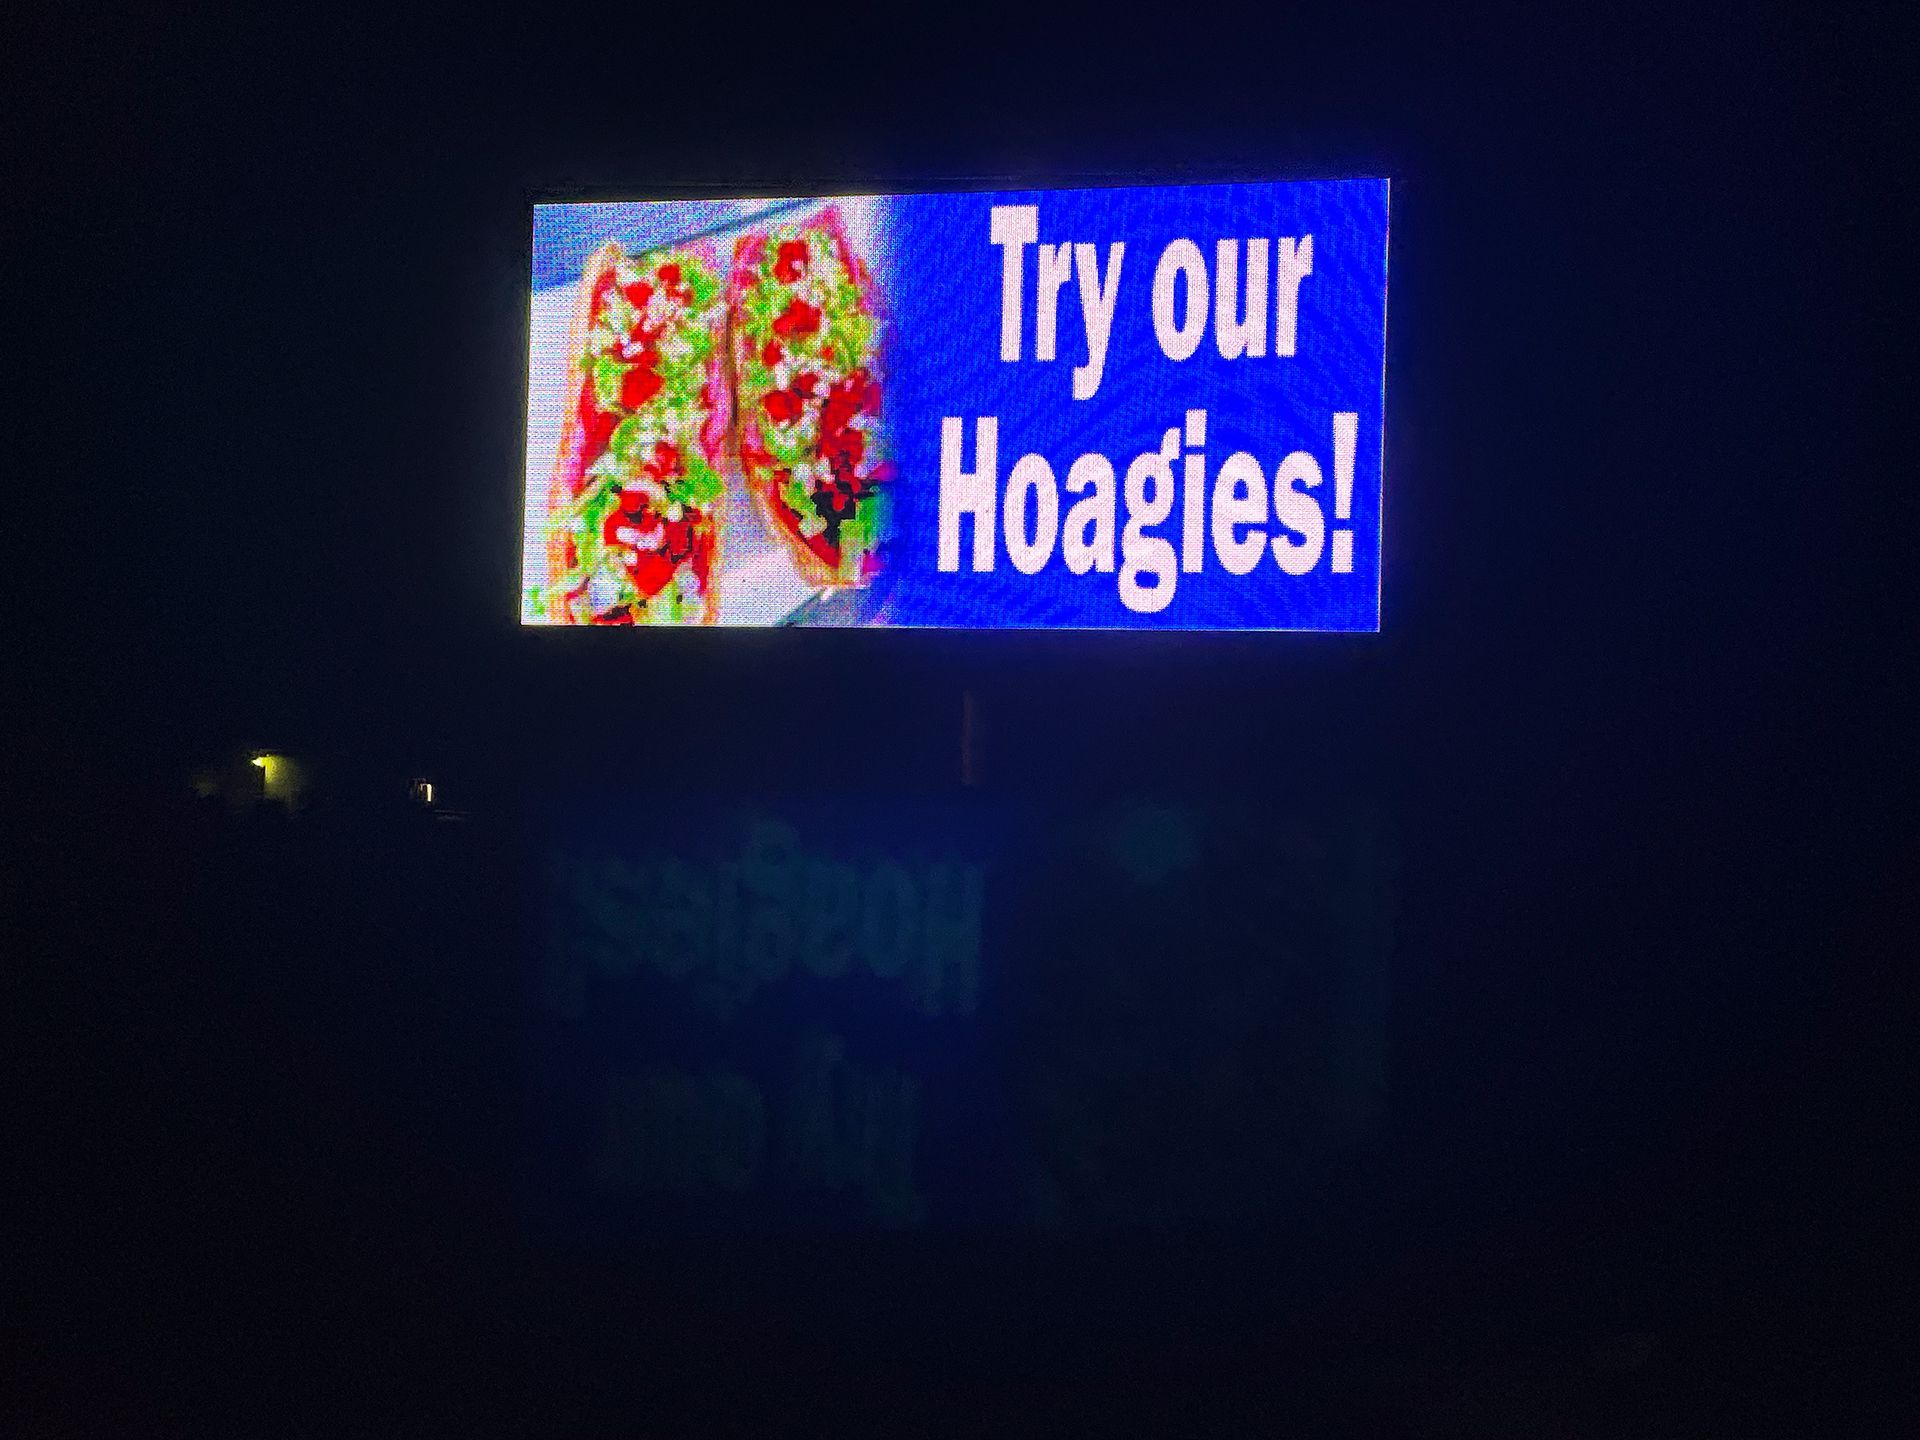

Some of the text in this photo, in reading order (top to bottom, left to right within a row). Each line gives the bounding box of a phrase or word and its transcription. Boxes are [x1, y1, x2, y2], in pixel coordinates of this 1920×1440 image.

[990, 204, 1314, 400] Try our
[937, 409, 1359, 614] Hoagies!
